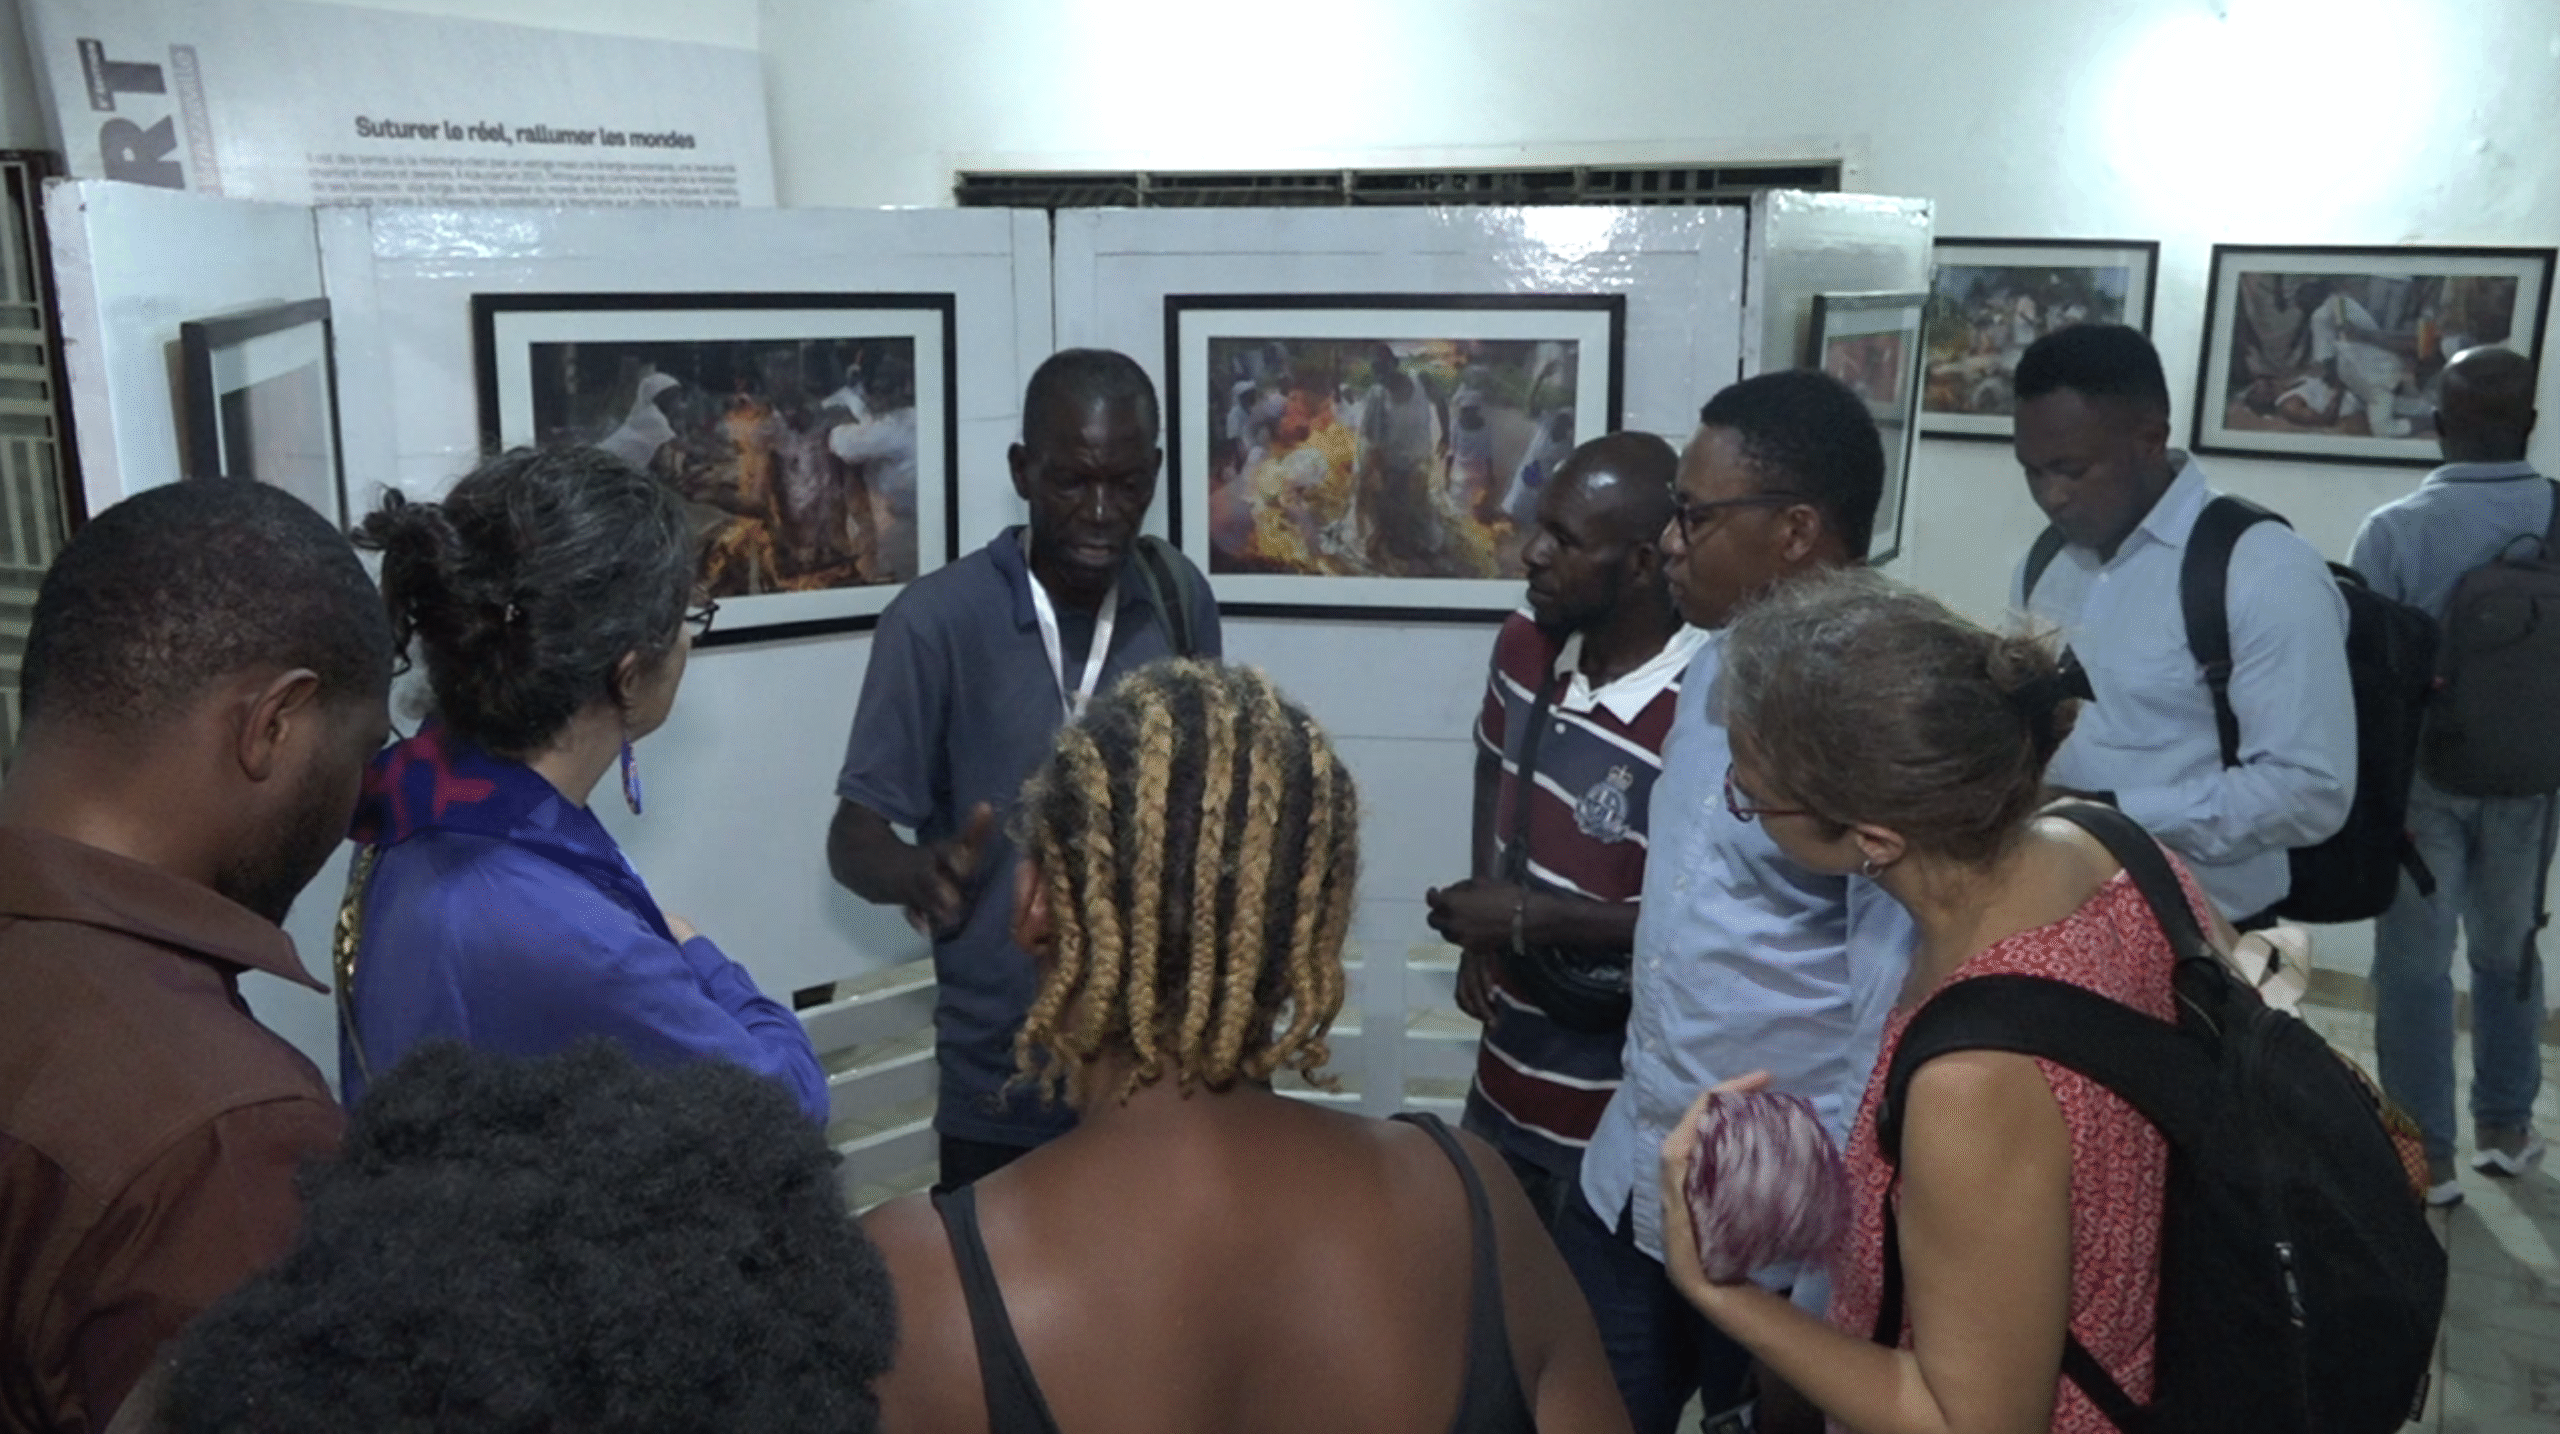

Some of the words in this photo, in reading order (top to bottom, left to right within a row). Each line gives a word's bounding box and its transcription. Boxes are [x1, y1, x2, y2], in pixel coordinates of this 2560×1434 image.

[355, 115, 439, 140] Suturer
[444, 120, 464, 141] le
[468, 121, 513, 146] réel,
[517, 124, 596, 146] rallumer
[600, 127, 626, 147] les
[629, 130, 696, 149] mondes
